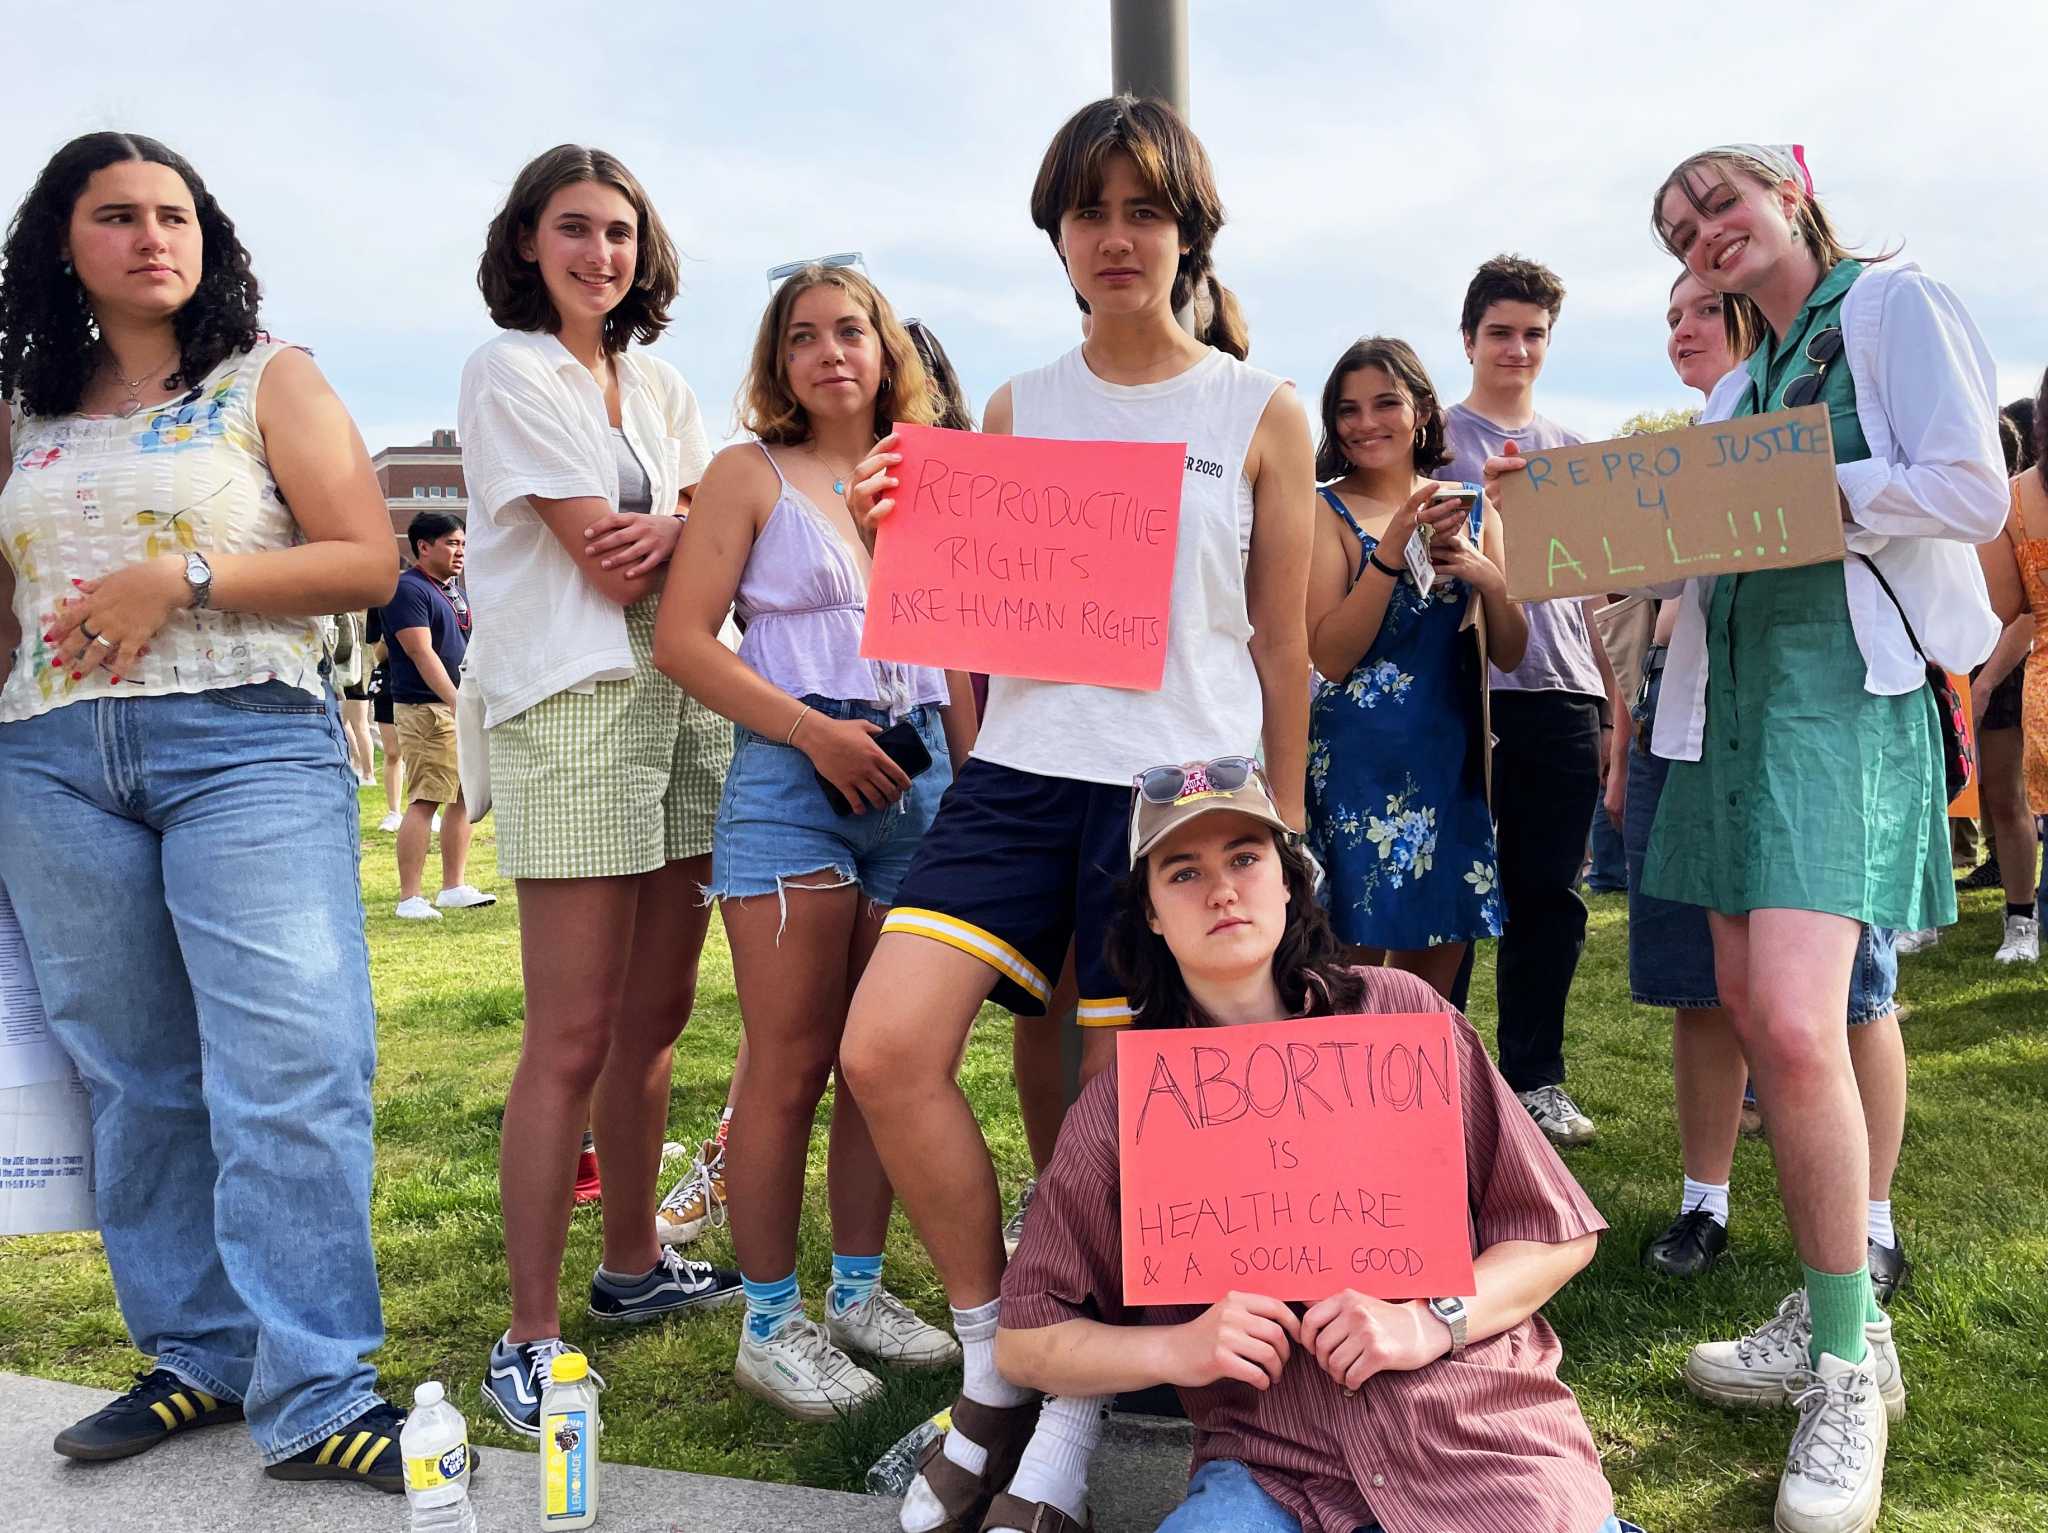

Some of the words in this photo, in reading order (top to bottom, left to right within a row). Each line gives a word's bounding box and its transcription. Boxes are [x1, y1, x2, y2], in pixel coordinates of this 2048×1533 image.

[1195, 459, 1223, 478] 2020
[1527, 447, 1681, 491] REPRO
[1707, 422, 1829, 467] JUSTICE
[914, 459, 1167, 544] REPRODUCTIVE
[1638, 488, 1669, 519] 4
[934, 536, 1090, 581] RIGHTS
[890, 588, 948, 625] ARE
[956, 592, 1065, 632] HUMAN
[1081, 601, 1159, 649] RIGHTS
[1136, 1037, 1450, 1145] ABORTION
[1139, 1191, 1292, 1245] HEALTH
[1308, 1188, 1405, 1228] CARE
[1143, 1256, 1161, 1286] &
[1184, 1252, 1203, 1284] A
[1230, 1246, 1333, 1276] SOCIAL
[1351, 1247, 1424, 1277] GOOD
